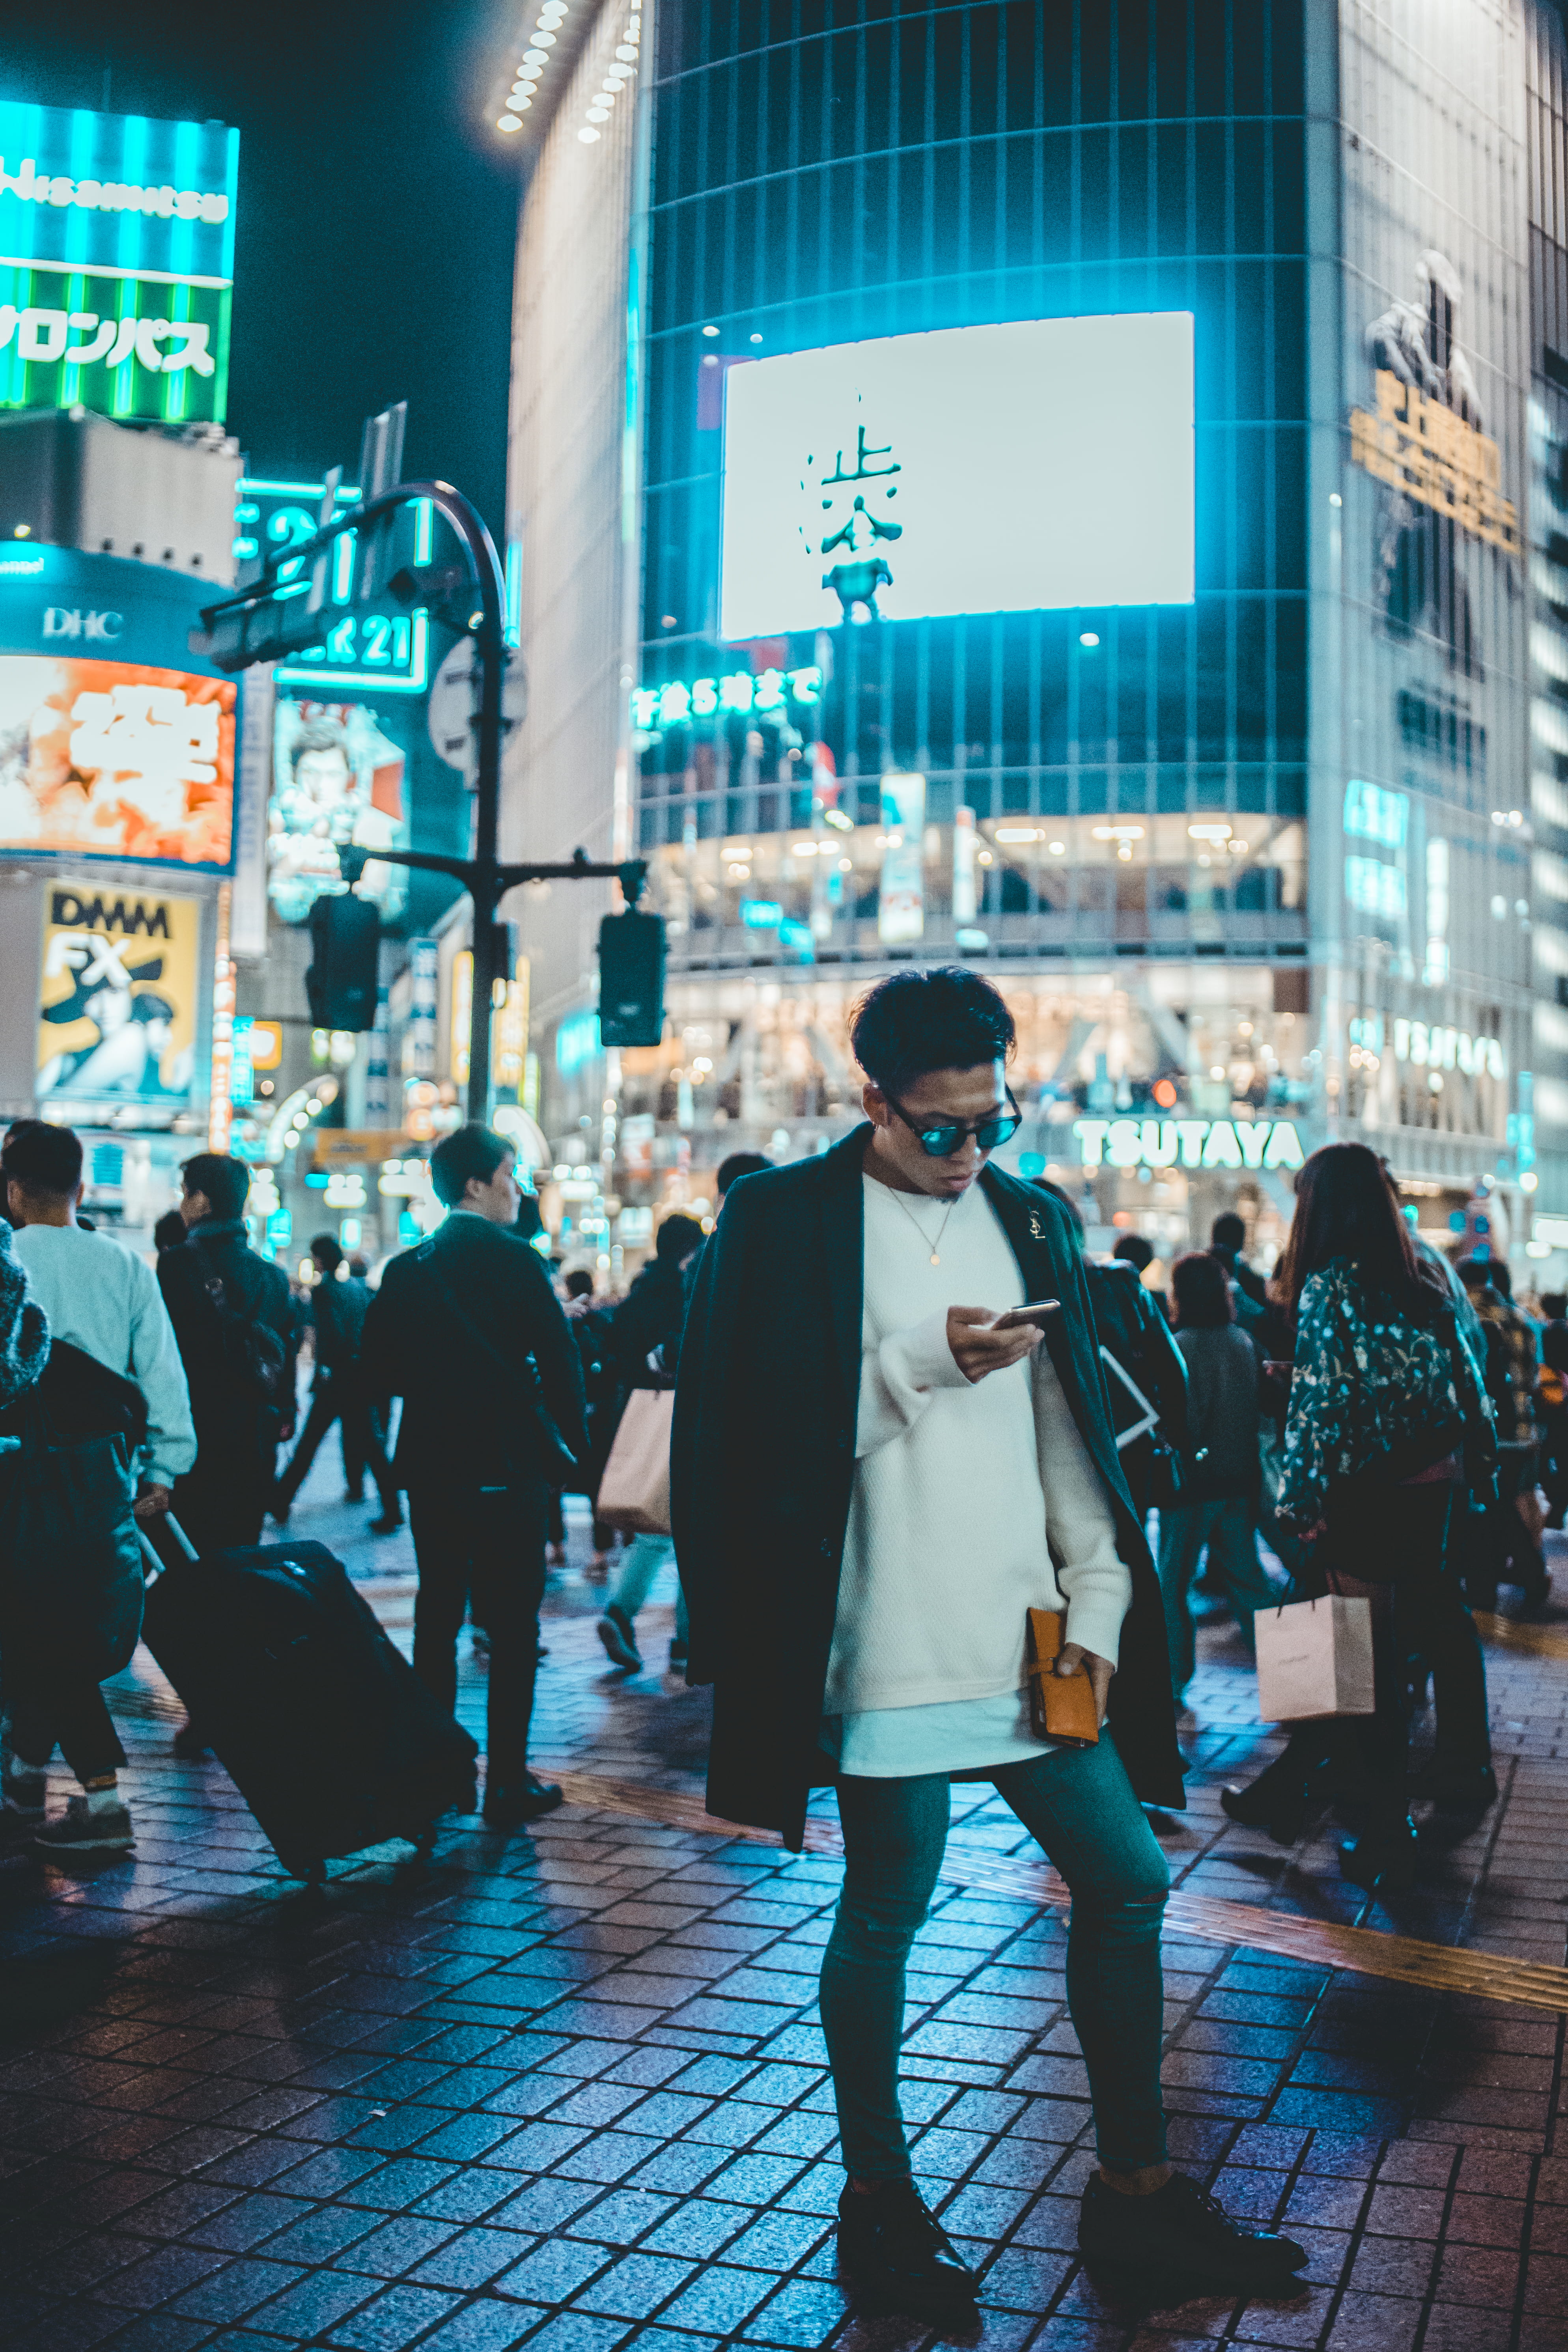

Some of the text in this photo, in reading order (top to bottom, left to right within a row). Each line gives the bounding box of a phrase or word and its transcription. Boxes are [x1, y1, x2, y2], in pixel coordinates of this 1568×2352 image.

[42, 607, 123, 640] DHC
[51, 891, 172, 939] DMM
[45, 931, 133, 986] FX
[1073, 1119, 1305, 1170] TSUTAYA
